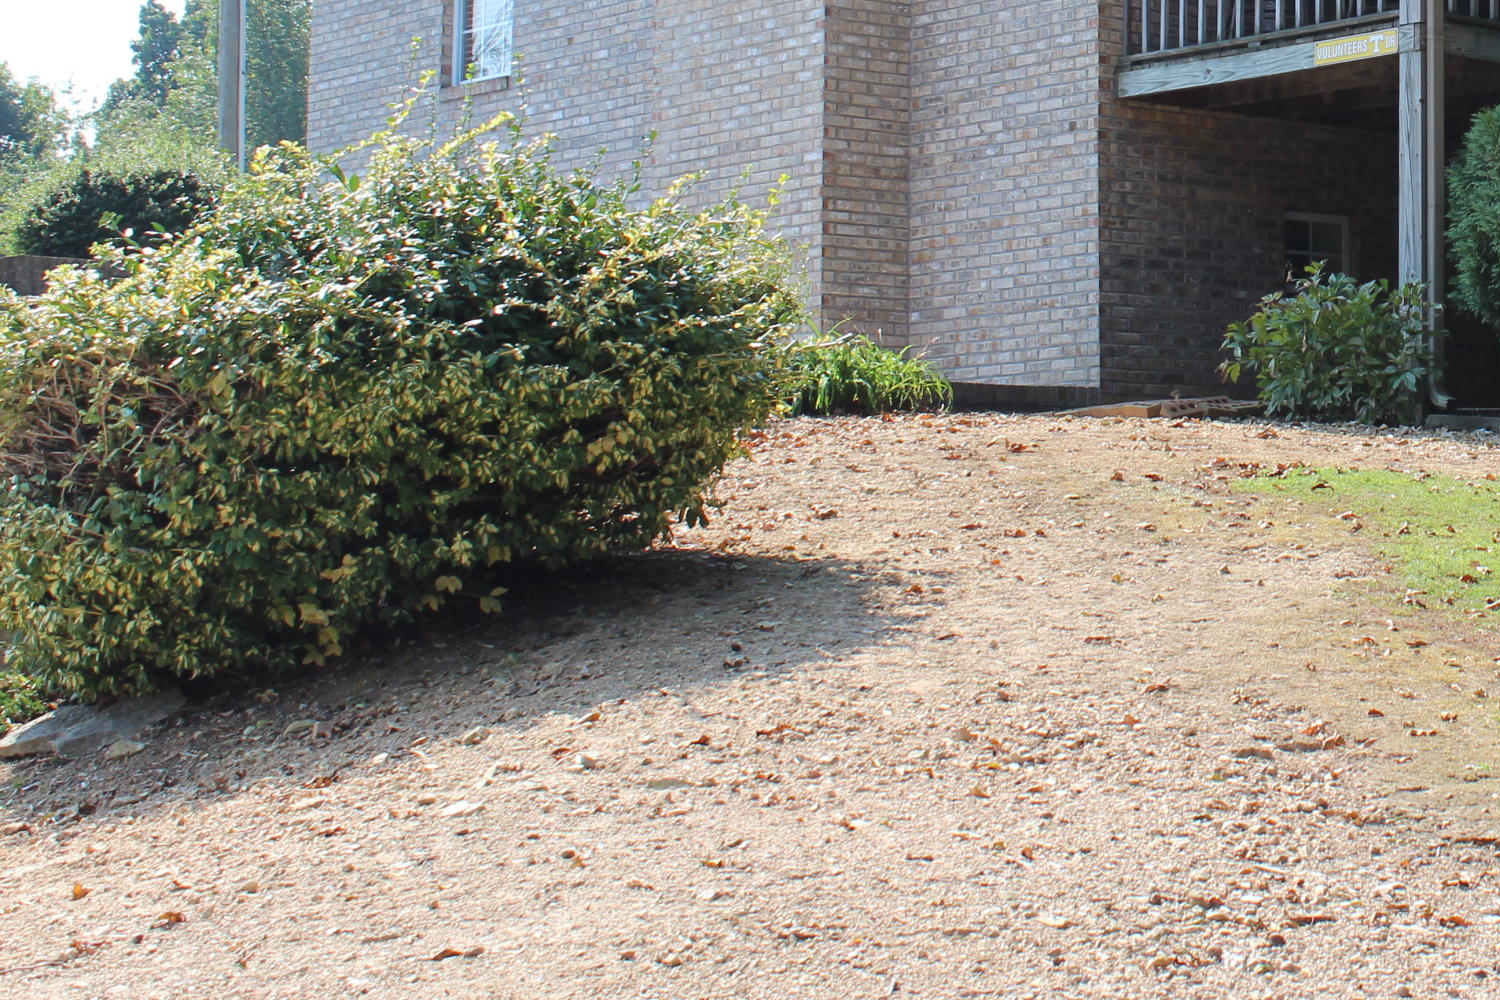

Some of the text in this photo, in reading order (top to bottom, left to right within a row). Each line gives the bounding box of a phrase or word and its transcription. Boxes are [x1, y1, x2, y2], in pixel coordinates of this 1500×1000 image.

[1317, 35, 1395, 59] VOLUNTEERS T DR
